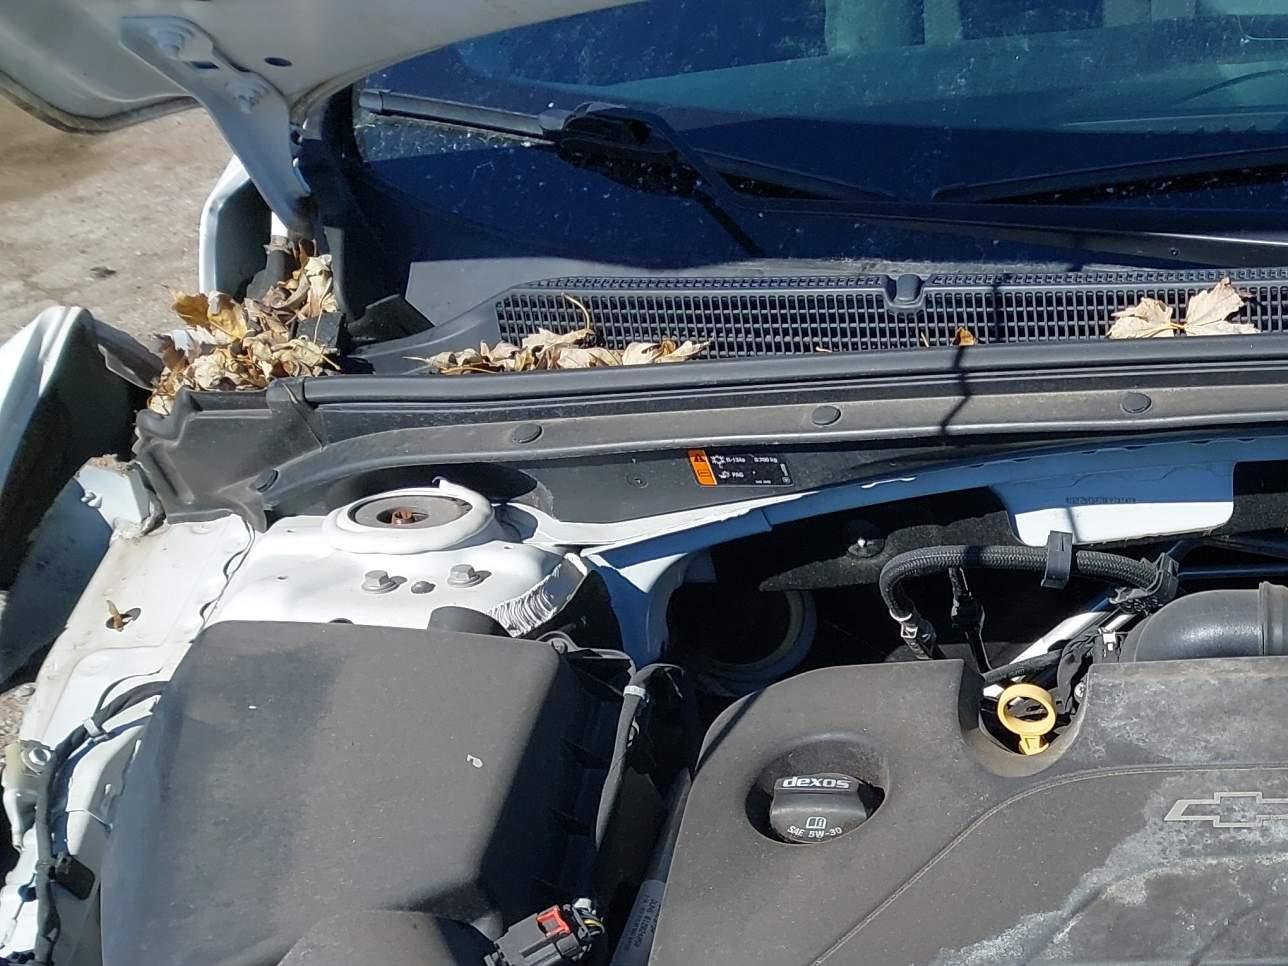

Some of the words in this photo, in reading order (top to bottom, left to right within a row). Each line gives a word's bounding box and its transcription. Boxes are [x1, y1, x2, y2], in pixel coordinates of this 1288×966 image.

[782, 776, 850, 789] dexos
[787, 825, 805, 837] SAE
[808, 826, 842, 838] 5W-30
